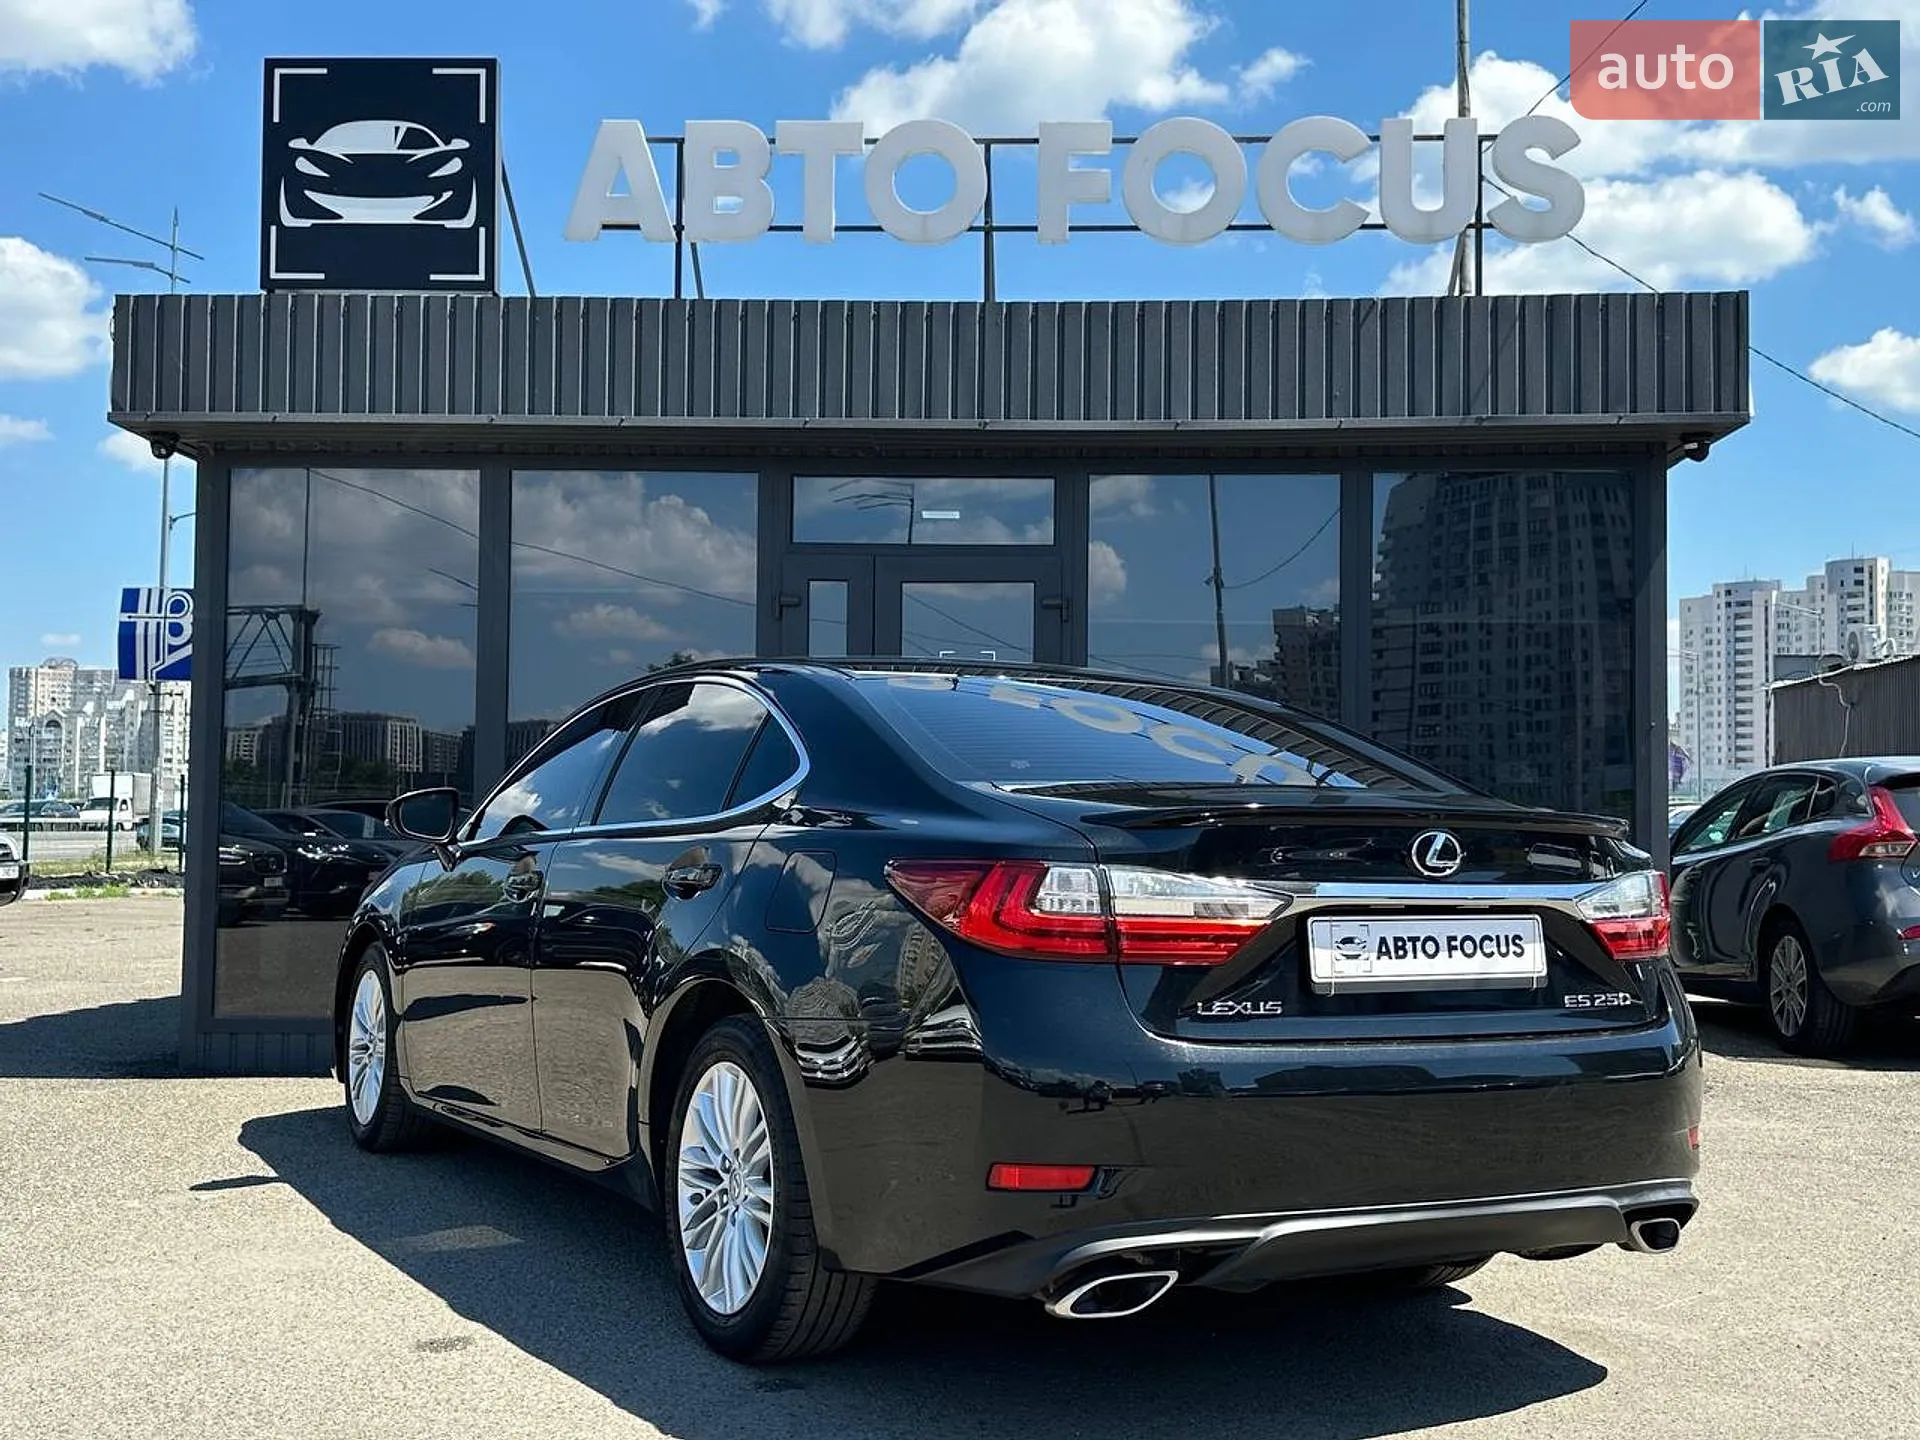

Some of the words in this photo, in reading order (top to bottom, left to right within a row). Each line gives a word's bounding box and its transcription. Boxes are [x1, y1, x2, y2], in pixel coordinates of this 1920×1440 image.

[1037, 116, 1585, 245] FOCUS
[1446, 934, 1525, 959] FOCUS
[1197, 1001, 1283, 1016] LEXUS
[1564, 994, 1591, 1008] ES
[1593, 992, 1632, 1007] 250
